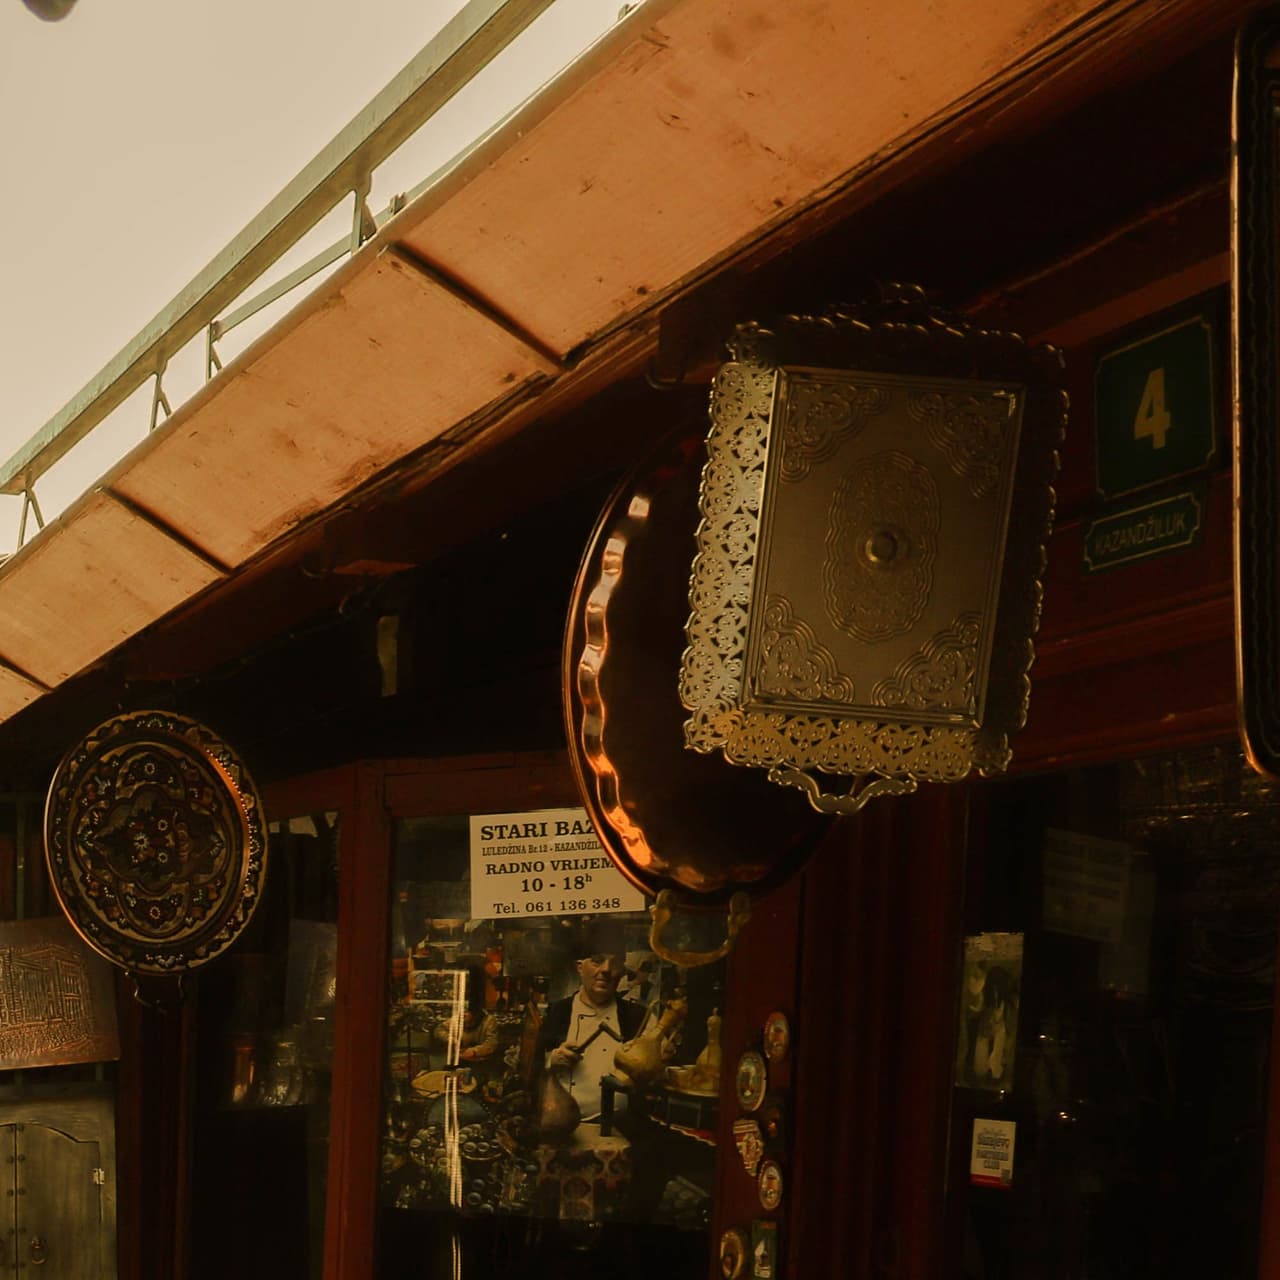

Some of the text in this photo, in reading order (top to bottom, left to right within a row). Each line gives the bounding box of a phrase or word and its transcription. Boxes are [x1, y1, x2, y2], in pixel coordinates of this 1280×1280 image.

[1133, 366, 1172, 450] 4
[1094, 511, 1187, 556] KAZANDŽILUK
[480, 822, 548, 841] STARI
[482, 843, 527, 857] LULEDŽINA
[485, 860, 545, 876] RADNO
[521, 877, 543, 892] 10
[493, 897, 621, 915] Tel. 061 136 348
